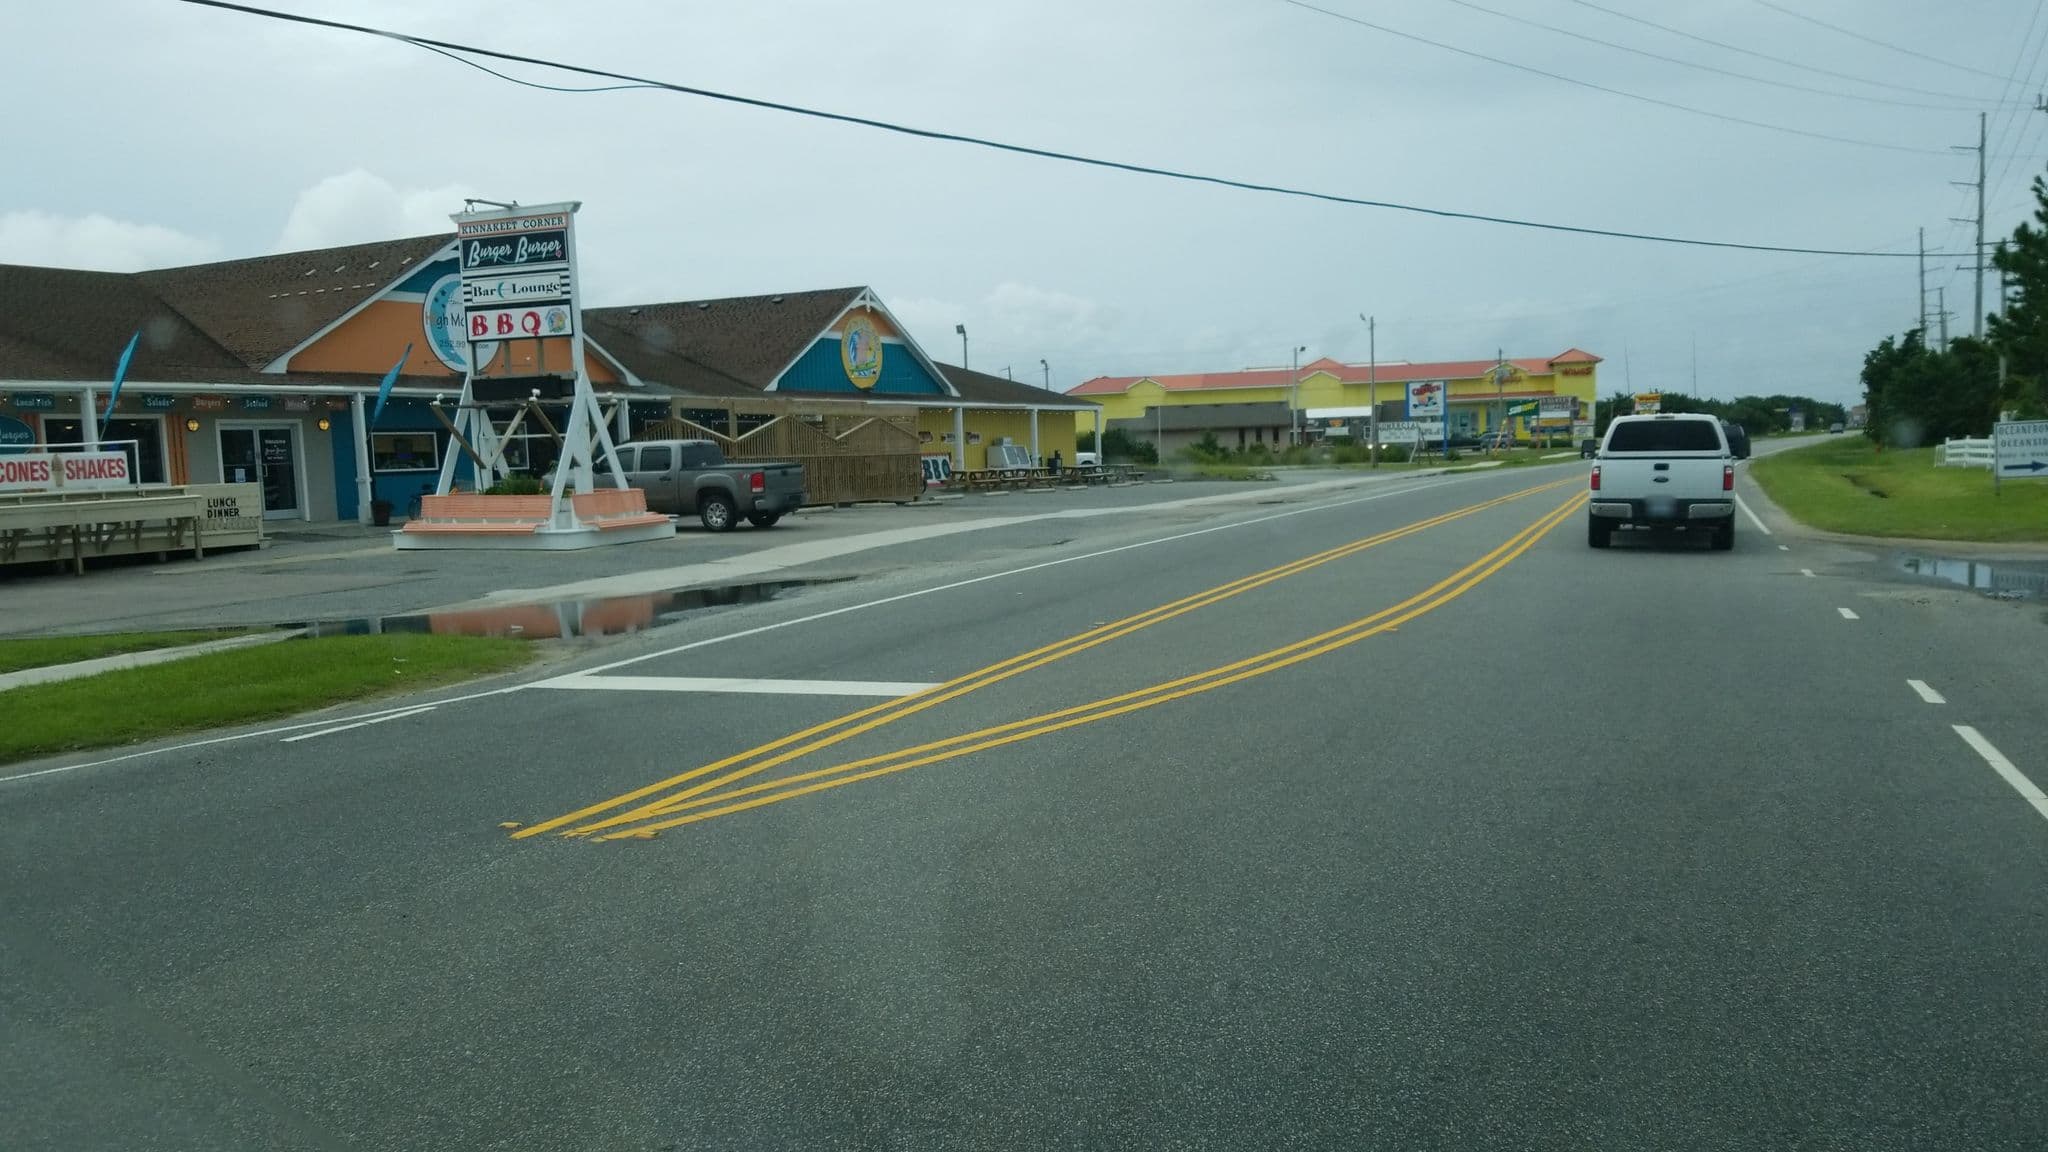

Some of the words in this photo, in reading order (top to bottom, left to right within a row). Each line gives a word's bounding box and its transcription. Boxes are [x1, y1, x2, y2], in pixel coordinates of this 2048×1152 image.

[462, 222, 518, 234] KINNAKEET
[523, 217, 564, 228] CORNER
[467, 240, 512, 267] Burger
[515, 236, 562, 263] Burger
[473, 286, 497, 297] Bar
[512, 282, 560, 294] Lounge
[0, 431, 29, 443] urger
[65, 458, 126, 480] SHAKES
[207, 498, 236, 508] LUNCH
[207, 508, 240, 518] DINNER
